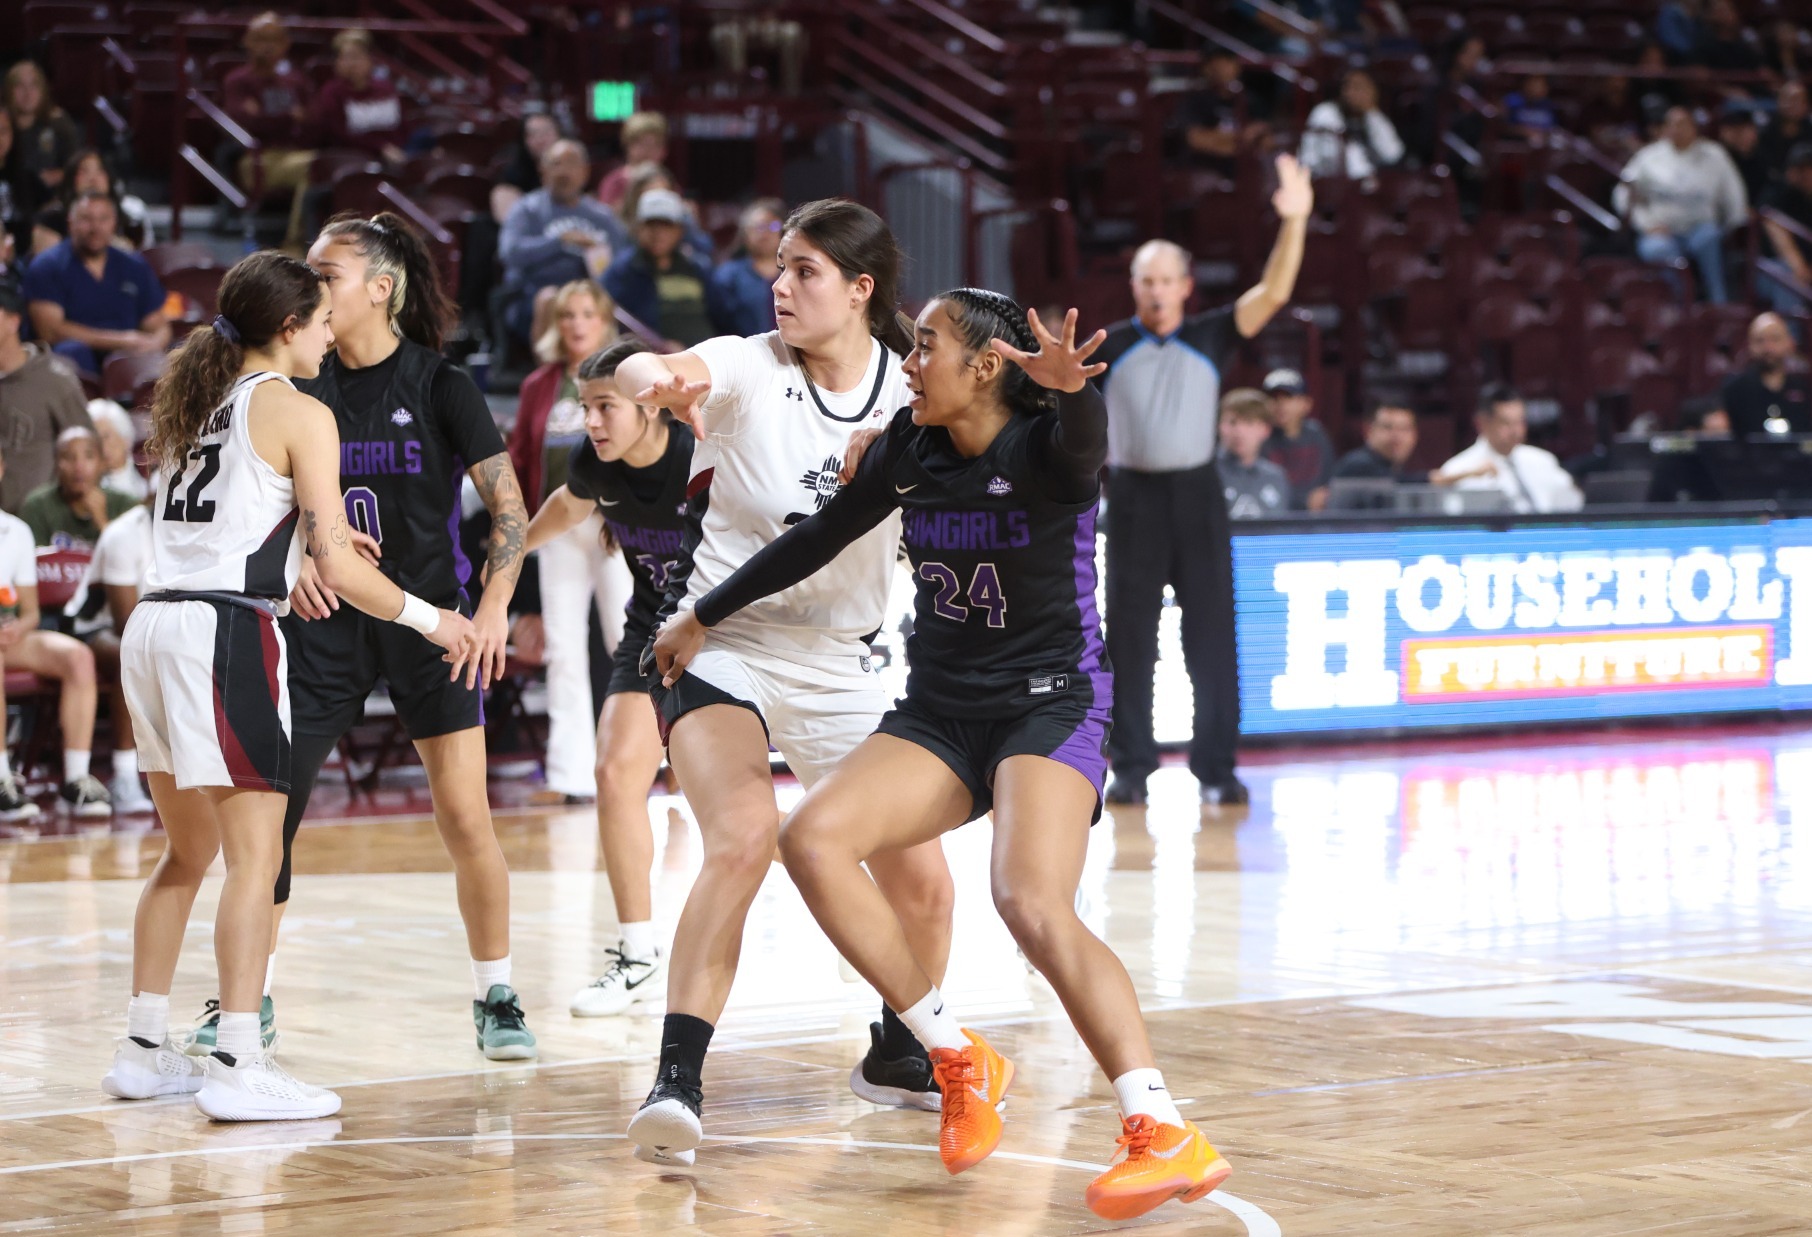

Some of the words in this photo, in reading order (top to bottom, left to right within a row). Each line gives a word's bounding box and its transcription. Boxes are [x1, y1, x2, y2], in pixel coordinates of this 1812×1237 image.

[163, 443, 222, 522] 22
[817, 483, 837, 492] STATE
[819, 474, 838, 486] NM
[989, 482, 1011, 491] RMAC
[342, 486, 383, 545] 0
[901, 508, 1031, 550] OWGIRLS
[919, 561, 1007, 629] 24
[1415, 635, 1762, 686] FURNITURE
[1056, 679, 1064, 688] M
